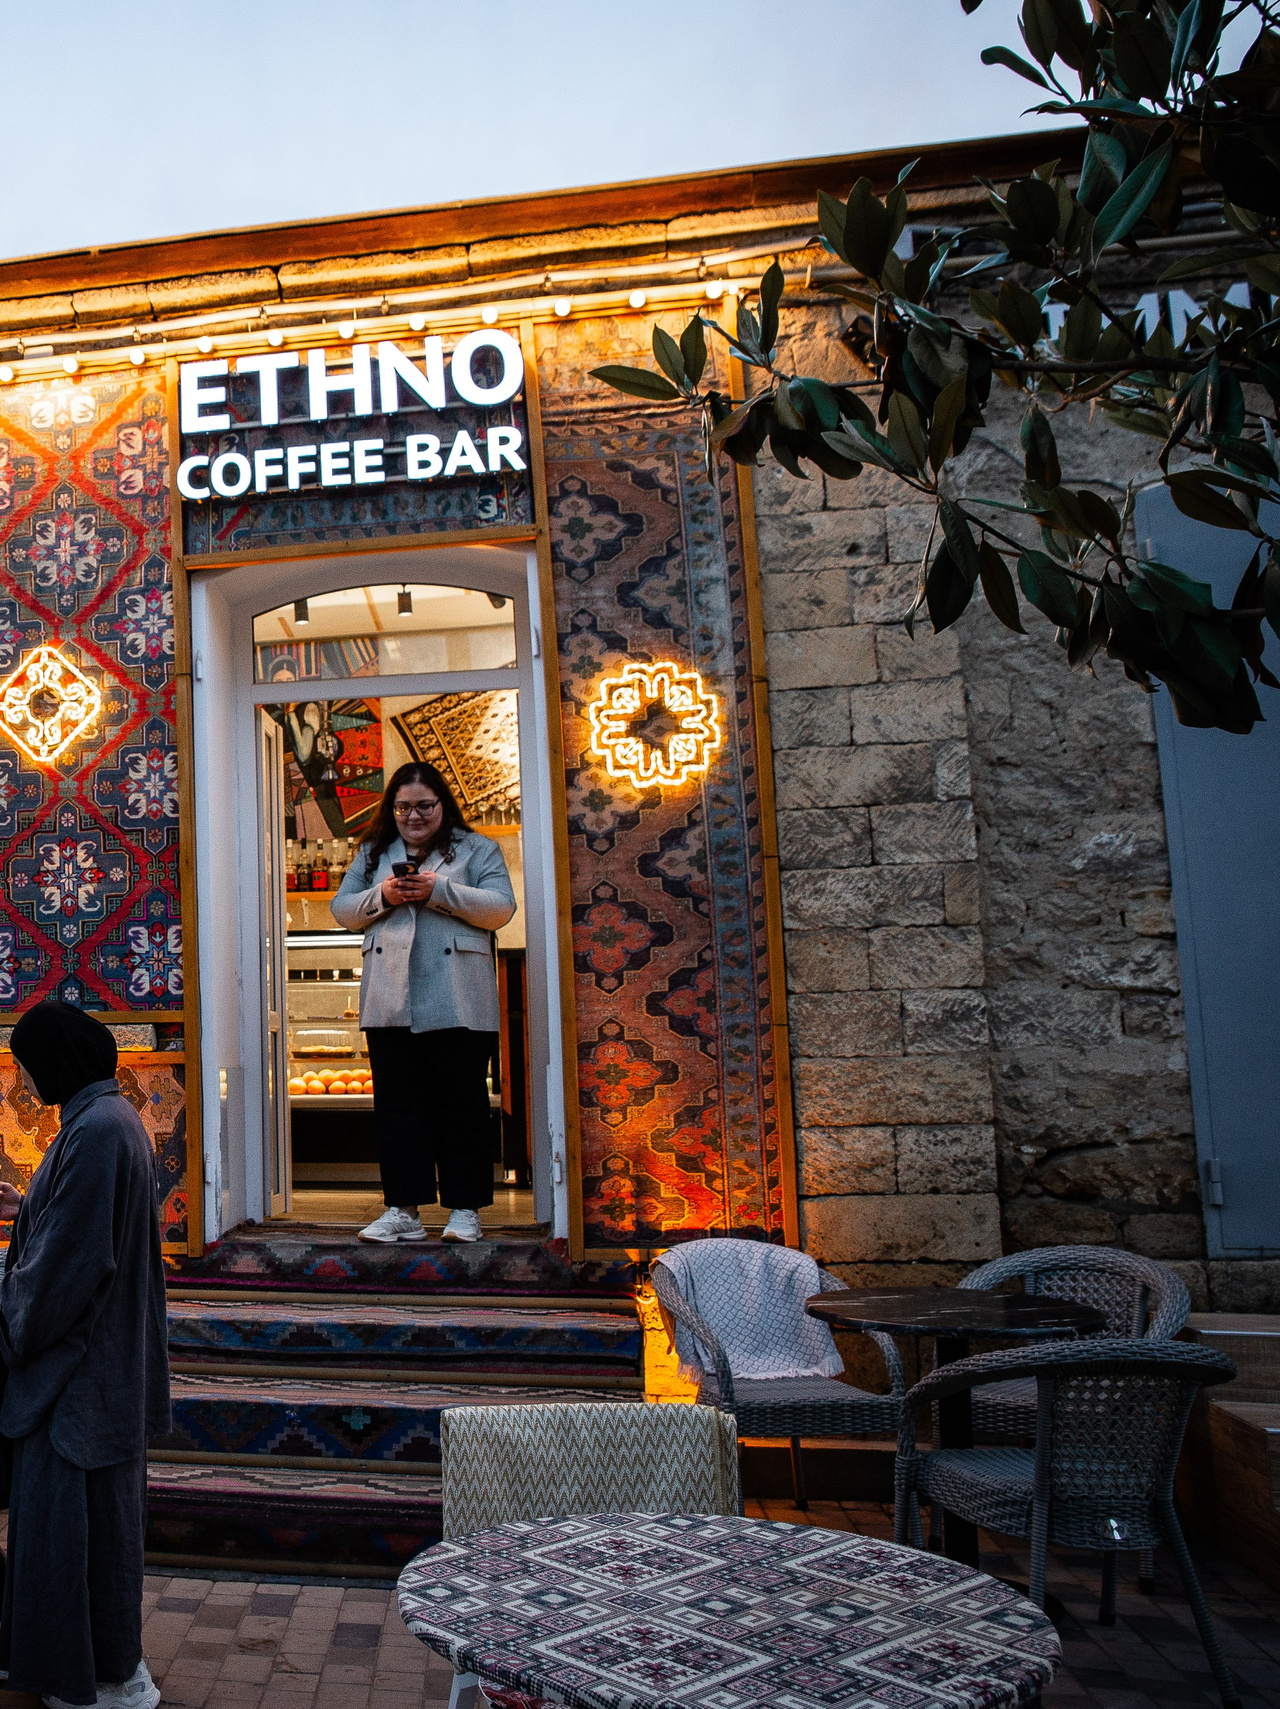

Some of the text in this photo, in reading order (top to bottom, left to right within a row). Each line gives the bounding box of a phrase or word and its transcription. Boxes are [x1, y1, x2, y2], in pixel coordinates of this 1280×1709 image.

[179, 328, 524, 434] ETHNO
[175, 426, 527, 500] COFFEE BAR
